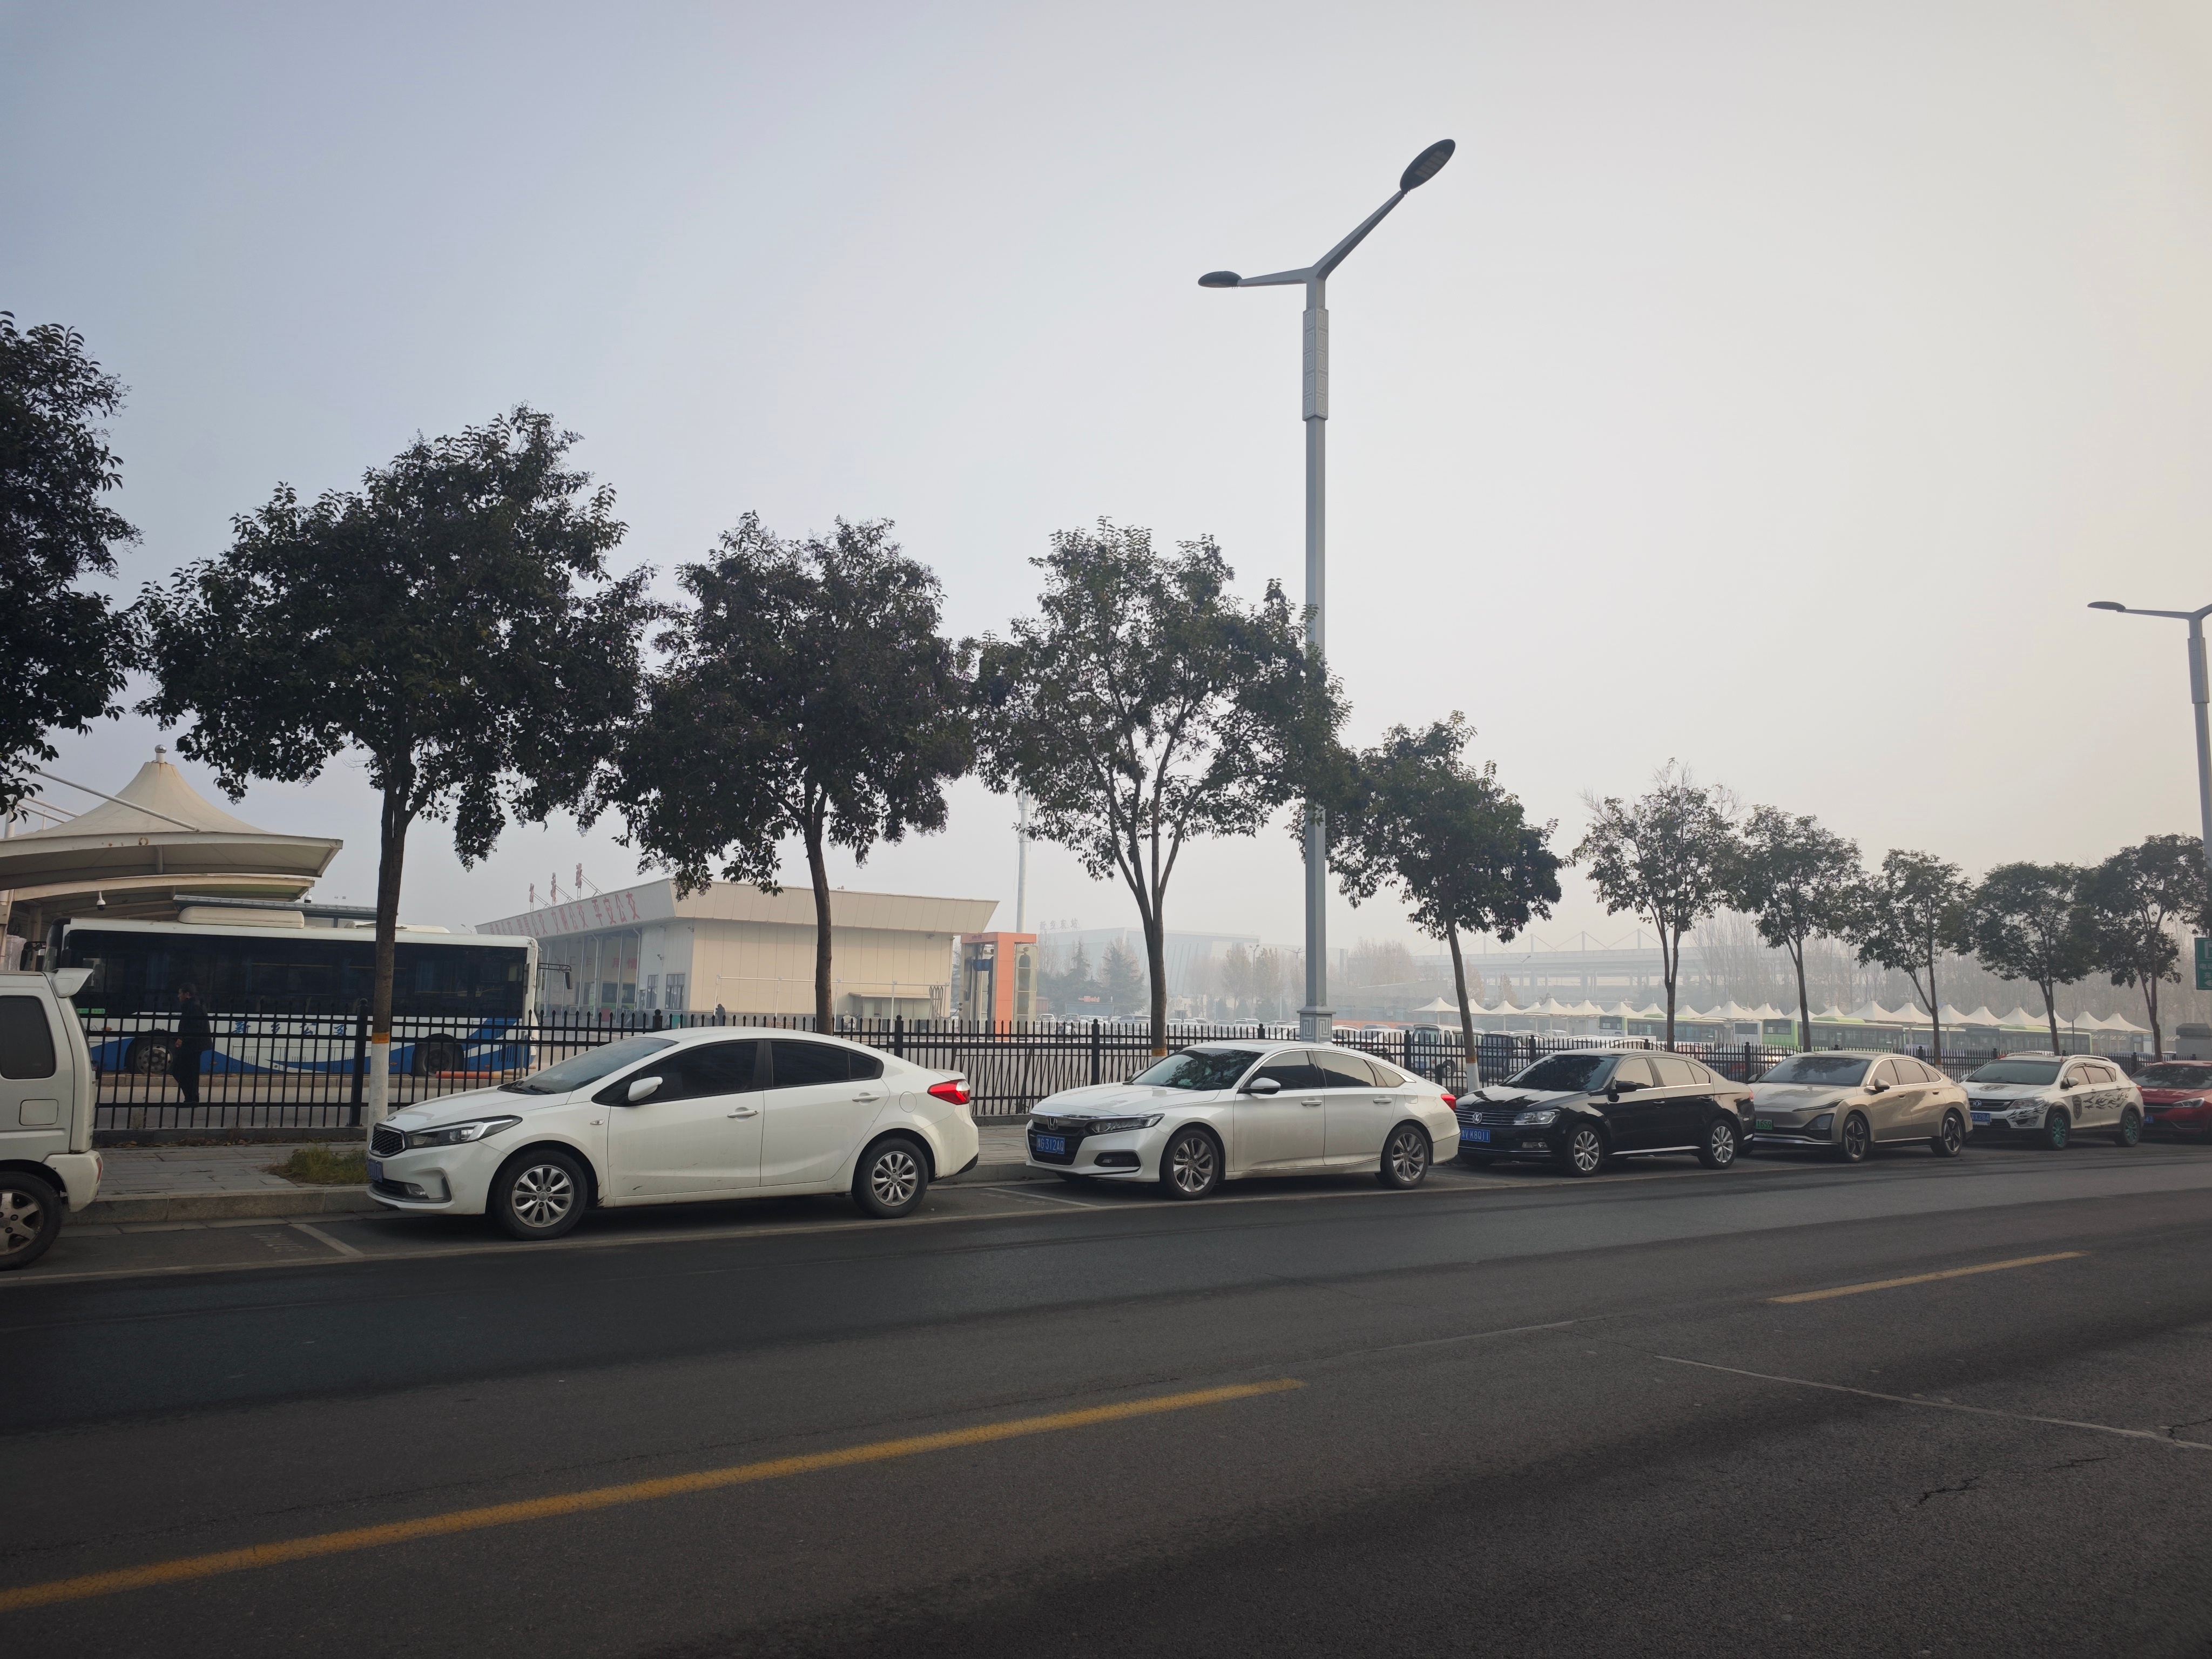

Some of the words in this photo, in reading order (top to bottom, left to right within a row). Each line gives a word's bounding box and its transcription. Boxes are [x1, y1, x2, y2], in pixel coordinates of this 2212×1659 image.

[591, 891, 640, 927] 平安公交
[1039, 918, 1080, 930] 新乡东站
